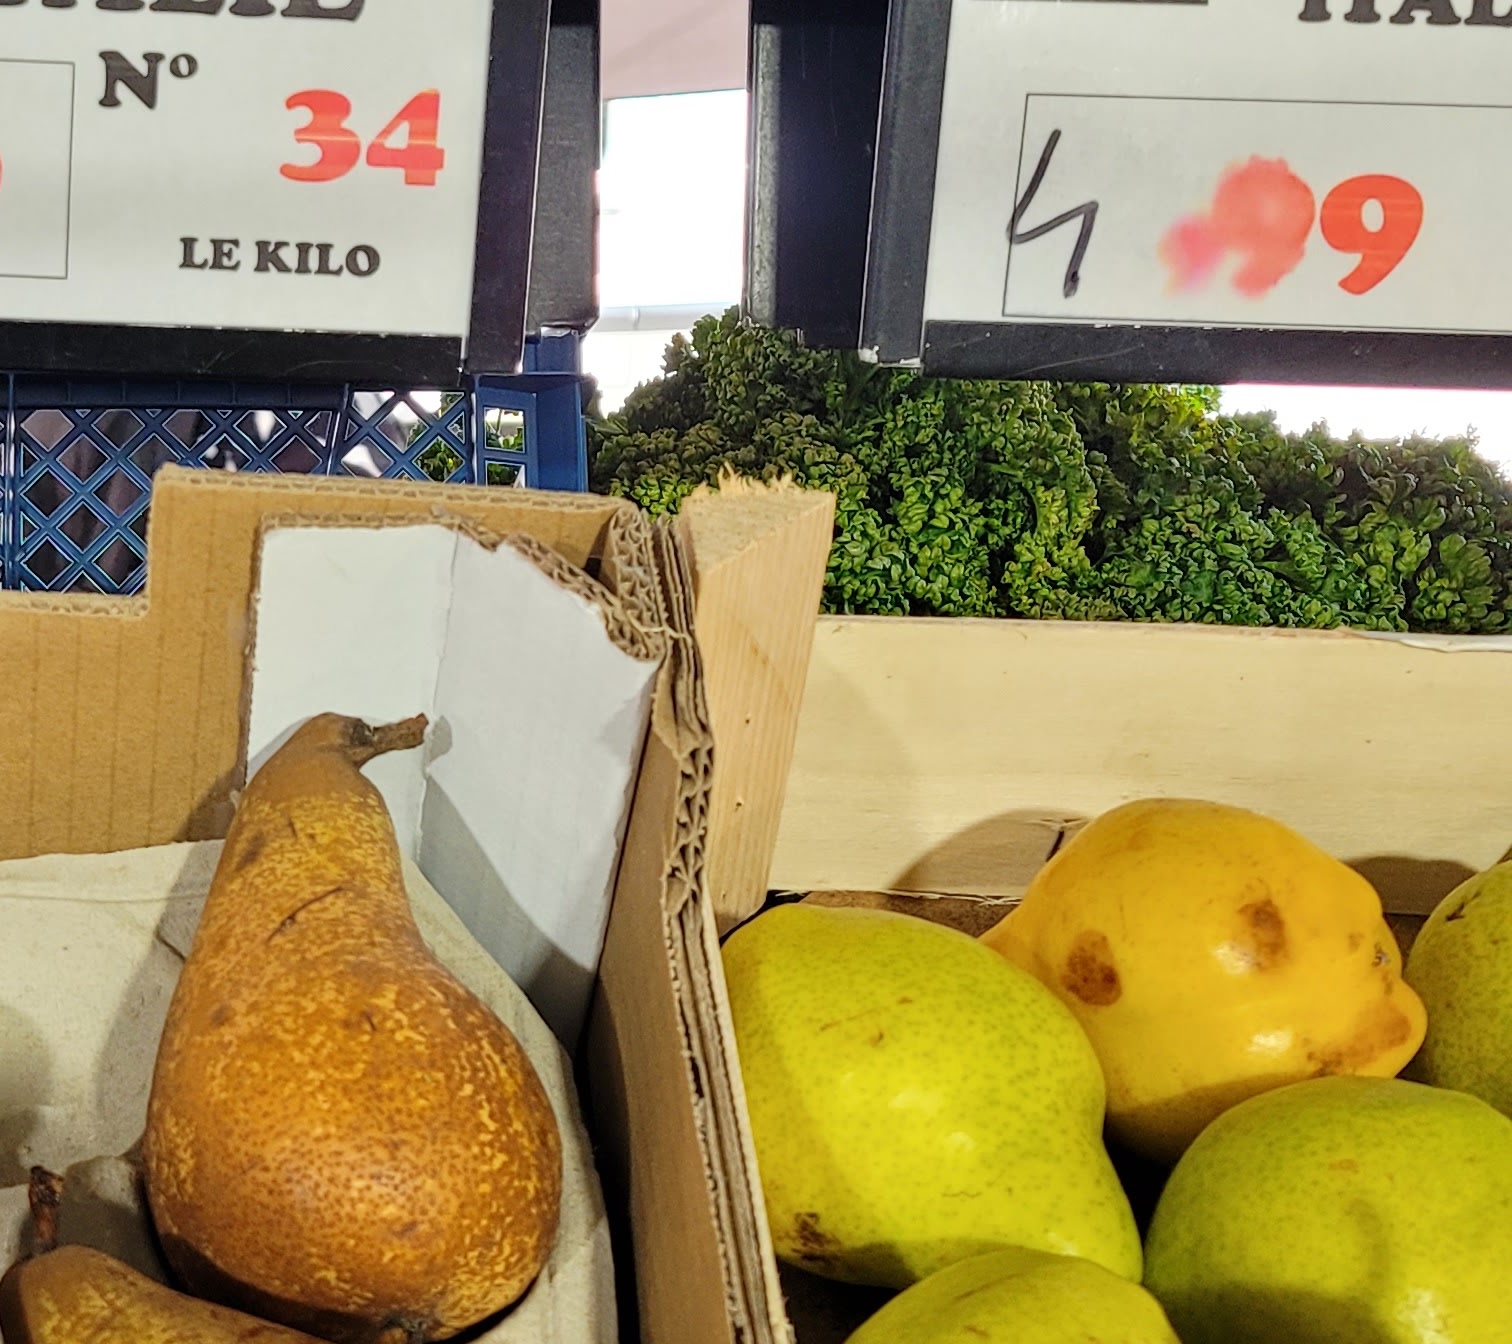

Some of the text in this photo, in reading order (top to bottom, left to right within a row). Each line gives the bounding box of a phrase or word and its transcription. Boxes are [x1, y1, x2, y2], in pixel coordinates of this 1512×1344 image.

[279, 87, 445, 187] 34
[178, 237, 380, 277] LE KILO
